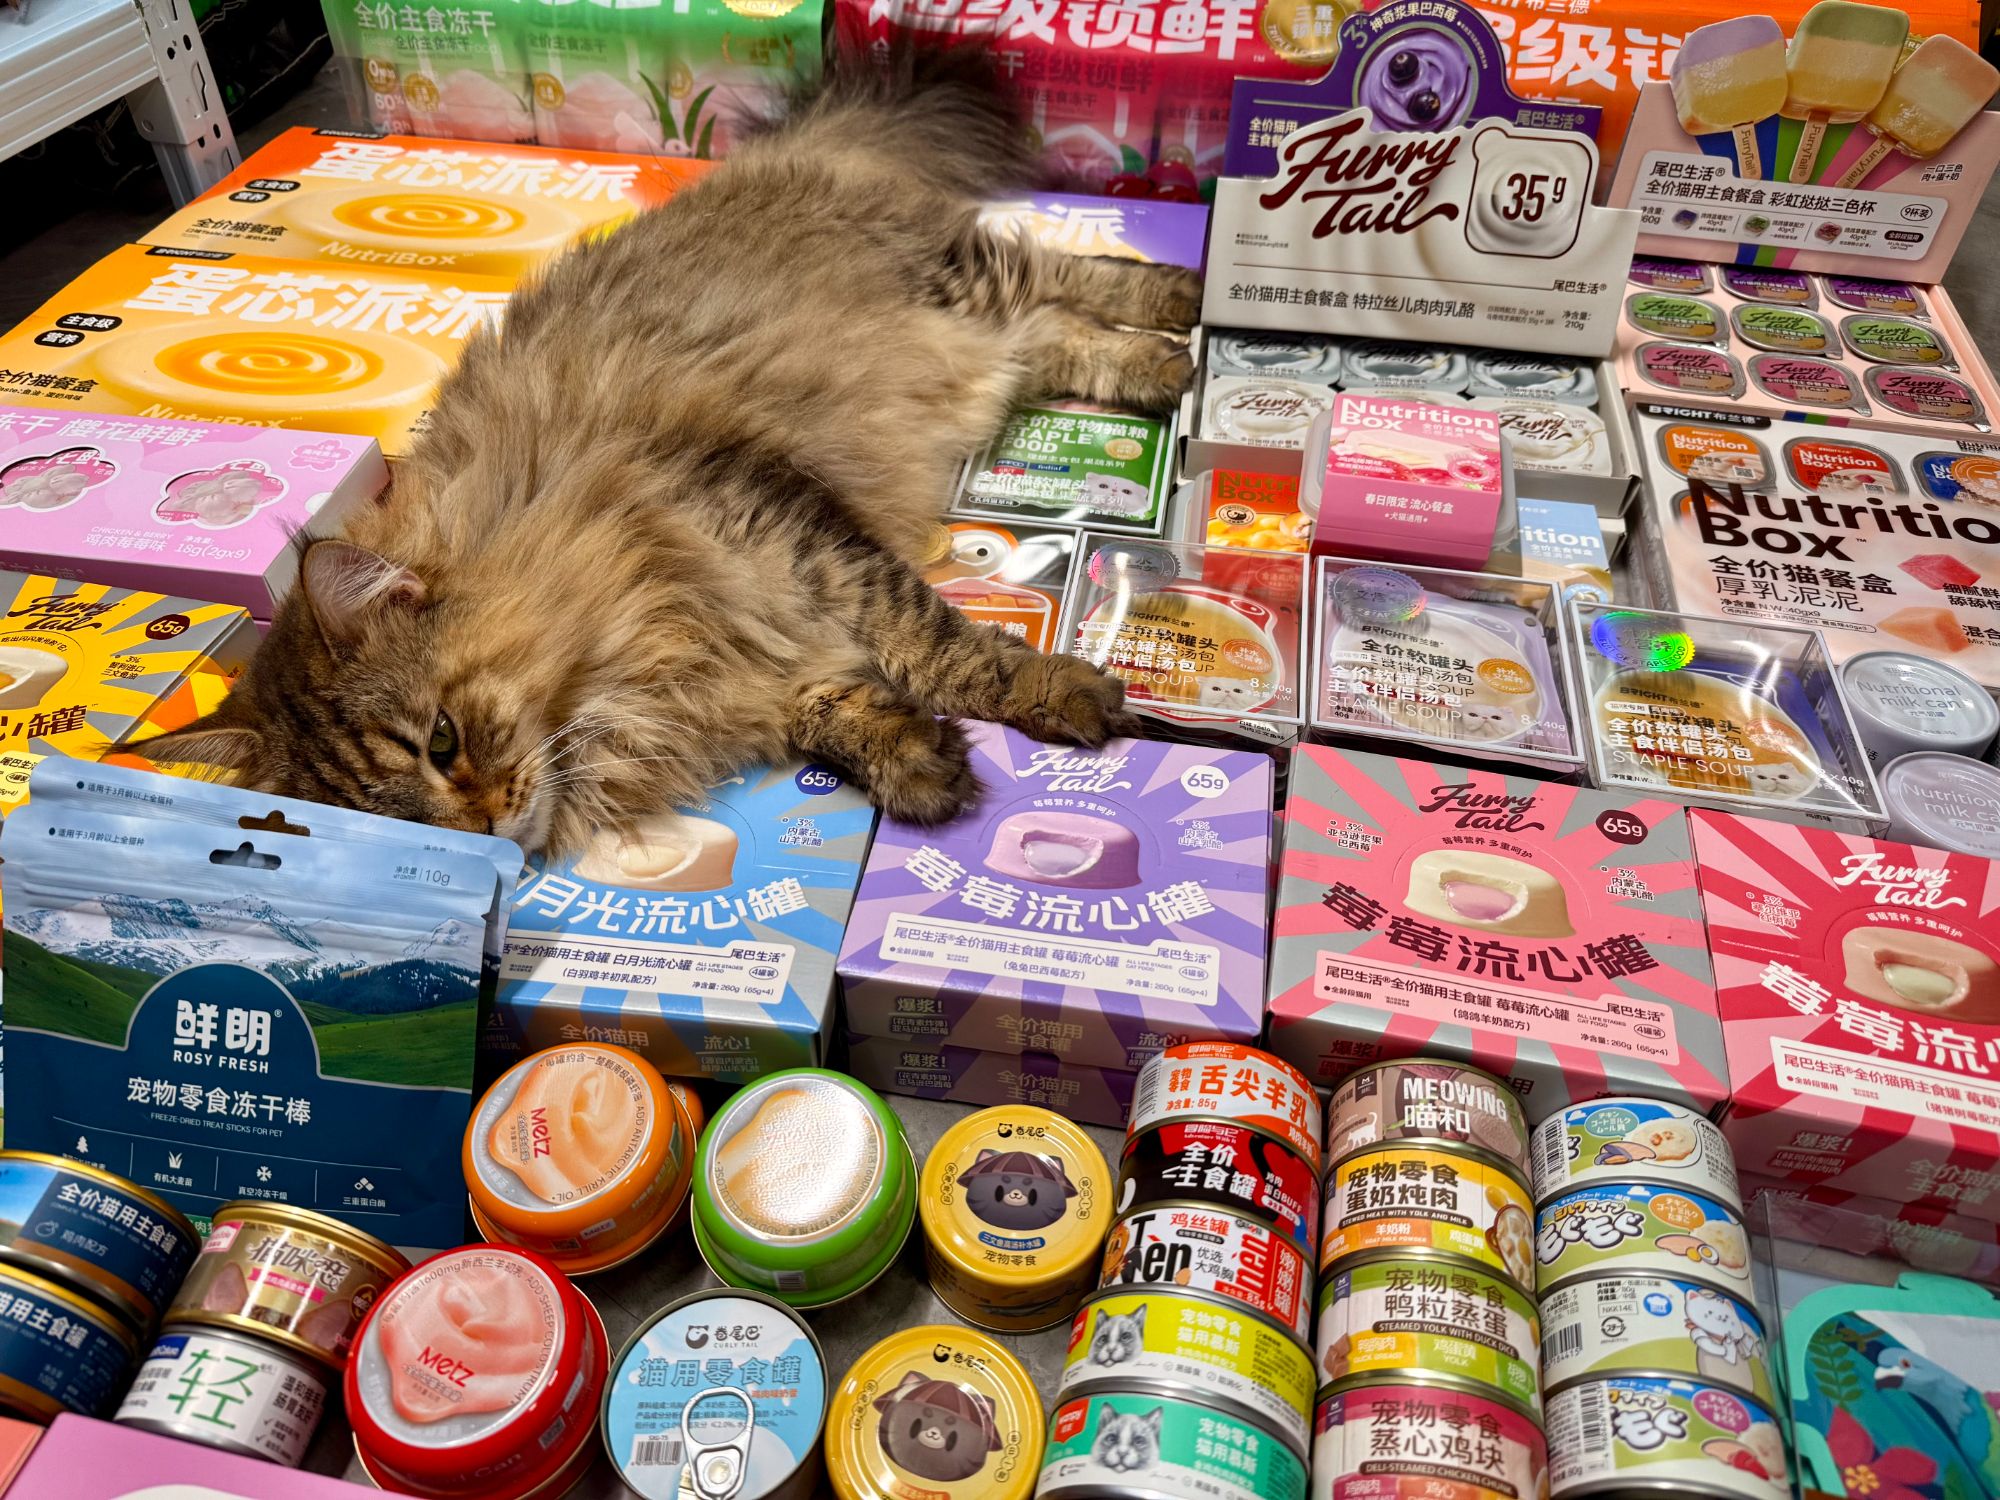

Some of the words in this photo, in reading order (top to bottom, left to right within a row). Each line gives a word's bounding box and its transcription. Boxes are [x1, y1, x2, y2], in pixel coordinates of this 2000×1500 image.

[353, 3, 496, 38] 全价主食冻干
[1370, 2, 1459, 33] 神奇浆果巴西莓
[301, 141, 640, 202] 蛋芯派派
[1260, 117, 1461, 210] Furry
[1925, 163, 1963, 174] 一口三色
[251, 179, 294, 191] 主食级
[1300, 177, 1460, 239] Tail
[1502, 173, 1567, 223] 35g
[1645, 179, 1766, 206] 全价猫用主食餐盒
[1769, 191, 1878, 217] 彩虹挞挞三色杯
[193, 217, 289, 238] 全价猫餐盒
[319, 240, 459, 266] NutriBox
[123, 262, 511, 341] 蛋芯派派
[1228, 283, 1349, 309] 全价猫用主食餐盒
[1352, 292, 1475, 319] 特拉丝儿肉肉乳酪
[62, 314, 117, 330] 主食级
[1564, 320, 1584, 331] 210g
[40, 332, 80, 346] 营养
[1340, 411, 1404, 432] Box
[1341, 398, 1495, 430] Nutrition
[1649, 404, 1712, 419] BRIGHT
[1713, 412, 1757, 424] 布兰德
[56, 417, 209, 447] 樱花鲜鲜
[1005, 427, 1094, 445] STAPLE
[1672, 433, 1748, 451] Nutrition
[1001, 437, 1058, 454] FOOD
[1798, 448, 1877, 468] Nutrition
[1217, 484, 1275, 504] Box
[1364, 493, 1410, 510] 春日限定
[1410, 497, 1454, 515] 流心餐盒
[91, 525, 132, 538] CHICKEN
[1699, 512, 1856, 563] Box
[1708, 554, 1897, 596] 全价猫餐盒
[7, 593, 114, 618] Furry
[1716, 575, 1864, 613] 厚乳泥泥
[23, 613, 103, 632] Tail
[149, 618, 186, 636] 65g
[1139, 671, 1195, 688] SOUP
[1856, 680, 1961, 697] Nutritional
[1327, 679, 1462, 708] 主食伴侣汤包
[1879, 696, 1919, 709] milk
[1925, 700, 1962, 710] can
[1327, 695, 1397, 714] STAPLE
[1406, 703, 1463, 722] SOUP
[1607, 717, 1725, 741] 全价软罐头
[1608, 731, 1755, 761] 主食伴侣汤包
[1014, 749, 1129, 781] Furry
[1613, 751, 1695, 772] STAPLE
[1699, 758, 1755, 778] SOUP
[799, 769, 839, 789] 65g
[1038, 772, 1133, 794] Tail
[1187, 771, 1225, 792] 65g
[87, 782, 174, 806] 适用于3月龄以上全猫种
[1418, 782, 1537, 815] Furry
[1444, 806, 1546, 833] Tail
[1924, 800, 1970, 818] milk
[787, 827, 820, 839] 内蒙古
[796, 817, 814, 828] 3%
[1184, 828, 1219, 840] 内蒙古
[1345, 821, 1364, 832] 3%
[1602, 815, 1644, 838] 65g
[57, 827, 145, 847] 适用于3月龄以上全猫种
[778, 835, 823, 848] 山羊乳酪
[1178, 837, 1224, 851] 山羊乳酪
[1337, 838, 1372, 852] 巴西莓
[394, 864, 418, 876] 净含量
[423, 868, 452, 888] 10g
[1617, 867, 1636, 879] 3%
[1832, 852, 1951, 885] Furry
[903, 842, 1216, 935] 莓莓流心罐
[1606, 886, 1656, 902] 山羊乳酪
[1611, 876, 1647, 891] 内蒙古
[1860, 878, 1967, 911] Tail
[1320, 881, 1660, 985] 莓莓流心罐
[613, 951, 693, 973] 白月光流心罐
[1052, 946, 1120, 968] 莓莓流心罐
[1330, 985, 1372, 1000] 全龄段猫用
[895, 997, 943, 1015] 爆浆!
[1496, 996, 1570, 1023] 莓莓流心罐
[1759, 958, 2000, 1076] 莓莓流
[173, 999, 272, 1057] 鲜朗
[559, 1022, 650, 1048] 全价猫用
[996, 1014, 1084, 1040] 全价猫用
[1005, 1033, 1073, 1053] 主食罐
[173, 1049, 214, 1069] ROSY
[218, 1055, 270, 1075] FRESH
[901, 1051, 948, 1069] 爆浆!
[126, 1075, 312, 1128] 宠物零食冻干棒
[1197, 1098, 1218, 1110] 85g
[1198, 1064, 1308, 1129] 舌尖羊乳
[1403, 1077, 1507, 1122] MEOWING
[150, 1111, 198, 1127] FREEZE-DRIED
[199, 1119, 224, 1132] TREAT
[225, 1123, 251, 1136] STICKS
[251, 1126, 267, 1137] FOR
[268, 1128, 284, 1139] PET
[1404, 1103, 1471, 1134] 喵和
[530, 1107, 551, 1159] Metz
[606, 1126, 643, 1181] ANTARCTIC
[1181, 1141, 1239, 1167] 全价
[153, 1172, 193, 1188] 有机大麦苗
[579, 1176, 607, 1196] KRILL
[1170, 1163, 1258, 1201] 主食罐
[1347, 1160, 1459, 1191] 宠物零食
[238, 1185, 288, 1201] 真空冷冻干燥
[342, 1196, 387, 1208] 三重蛋白酶
[557, 1190, 574, 1202] OIL
[1346, 1184, 1458, 1214] 蛋奶炖肉
[1906, 1177, 1992, 1204] 主食罐
[1169, 1212, 1231, 1237] 鸡丝罐
[1342, 1213, 1365, 1226] STEWED
[1366, 1210, 1385, 1220] MEAT
[1408, 1209, 1429, 1218] YOLK
[1431, 1212, 1448, 1220] AND
[1449, 1216, 1467, 1225] MILK
[1376, 1223, 1411, 1236] 羊奶粉
[983, 1249, 1037, 1266] 宠物零食
[1196, 1246, 1224, 1264] 优选
[1273, 1247, 1297, 1319] 嫩嫩罐
[1385, 1268, 1506, 1314] 宠物零食
[538, 1294, 556, 1328] SHEEP
[1179, 1307, 1243, 1339] 宠物零食
[1385, 1293, 1507, 1341] 鸭粒蒸蛋
[1178, 1327, 1241, 1356] 猫用慕斯
[1357, 1335, 1397, 1353] 鸭胸肉
[1379, 1321, 1421, 1332] STEAMED
[1423, 1323, 1447, 1335] YOLK
[1450, 1327, 1473, 1341] WITH
[1474, 1333, 1498, 1348] DUCK
[1499, 1341, 1516, 1356] DICE
[417, 1346, 475, 1388] Metz
[638, 1356, 802, 1387] 猫用零食罐
[166, 1348, 260, 1431] 轻
[1370, 1398, 1503, 1446] 宠物零食
[1198, 1417, 1260, 1454] 宠物零食
[1370, 1427, 1506, 1476] 蒸心鸡块
[1365, 1462, 1435, 1475] DELI-STEAMED
